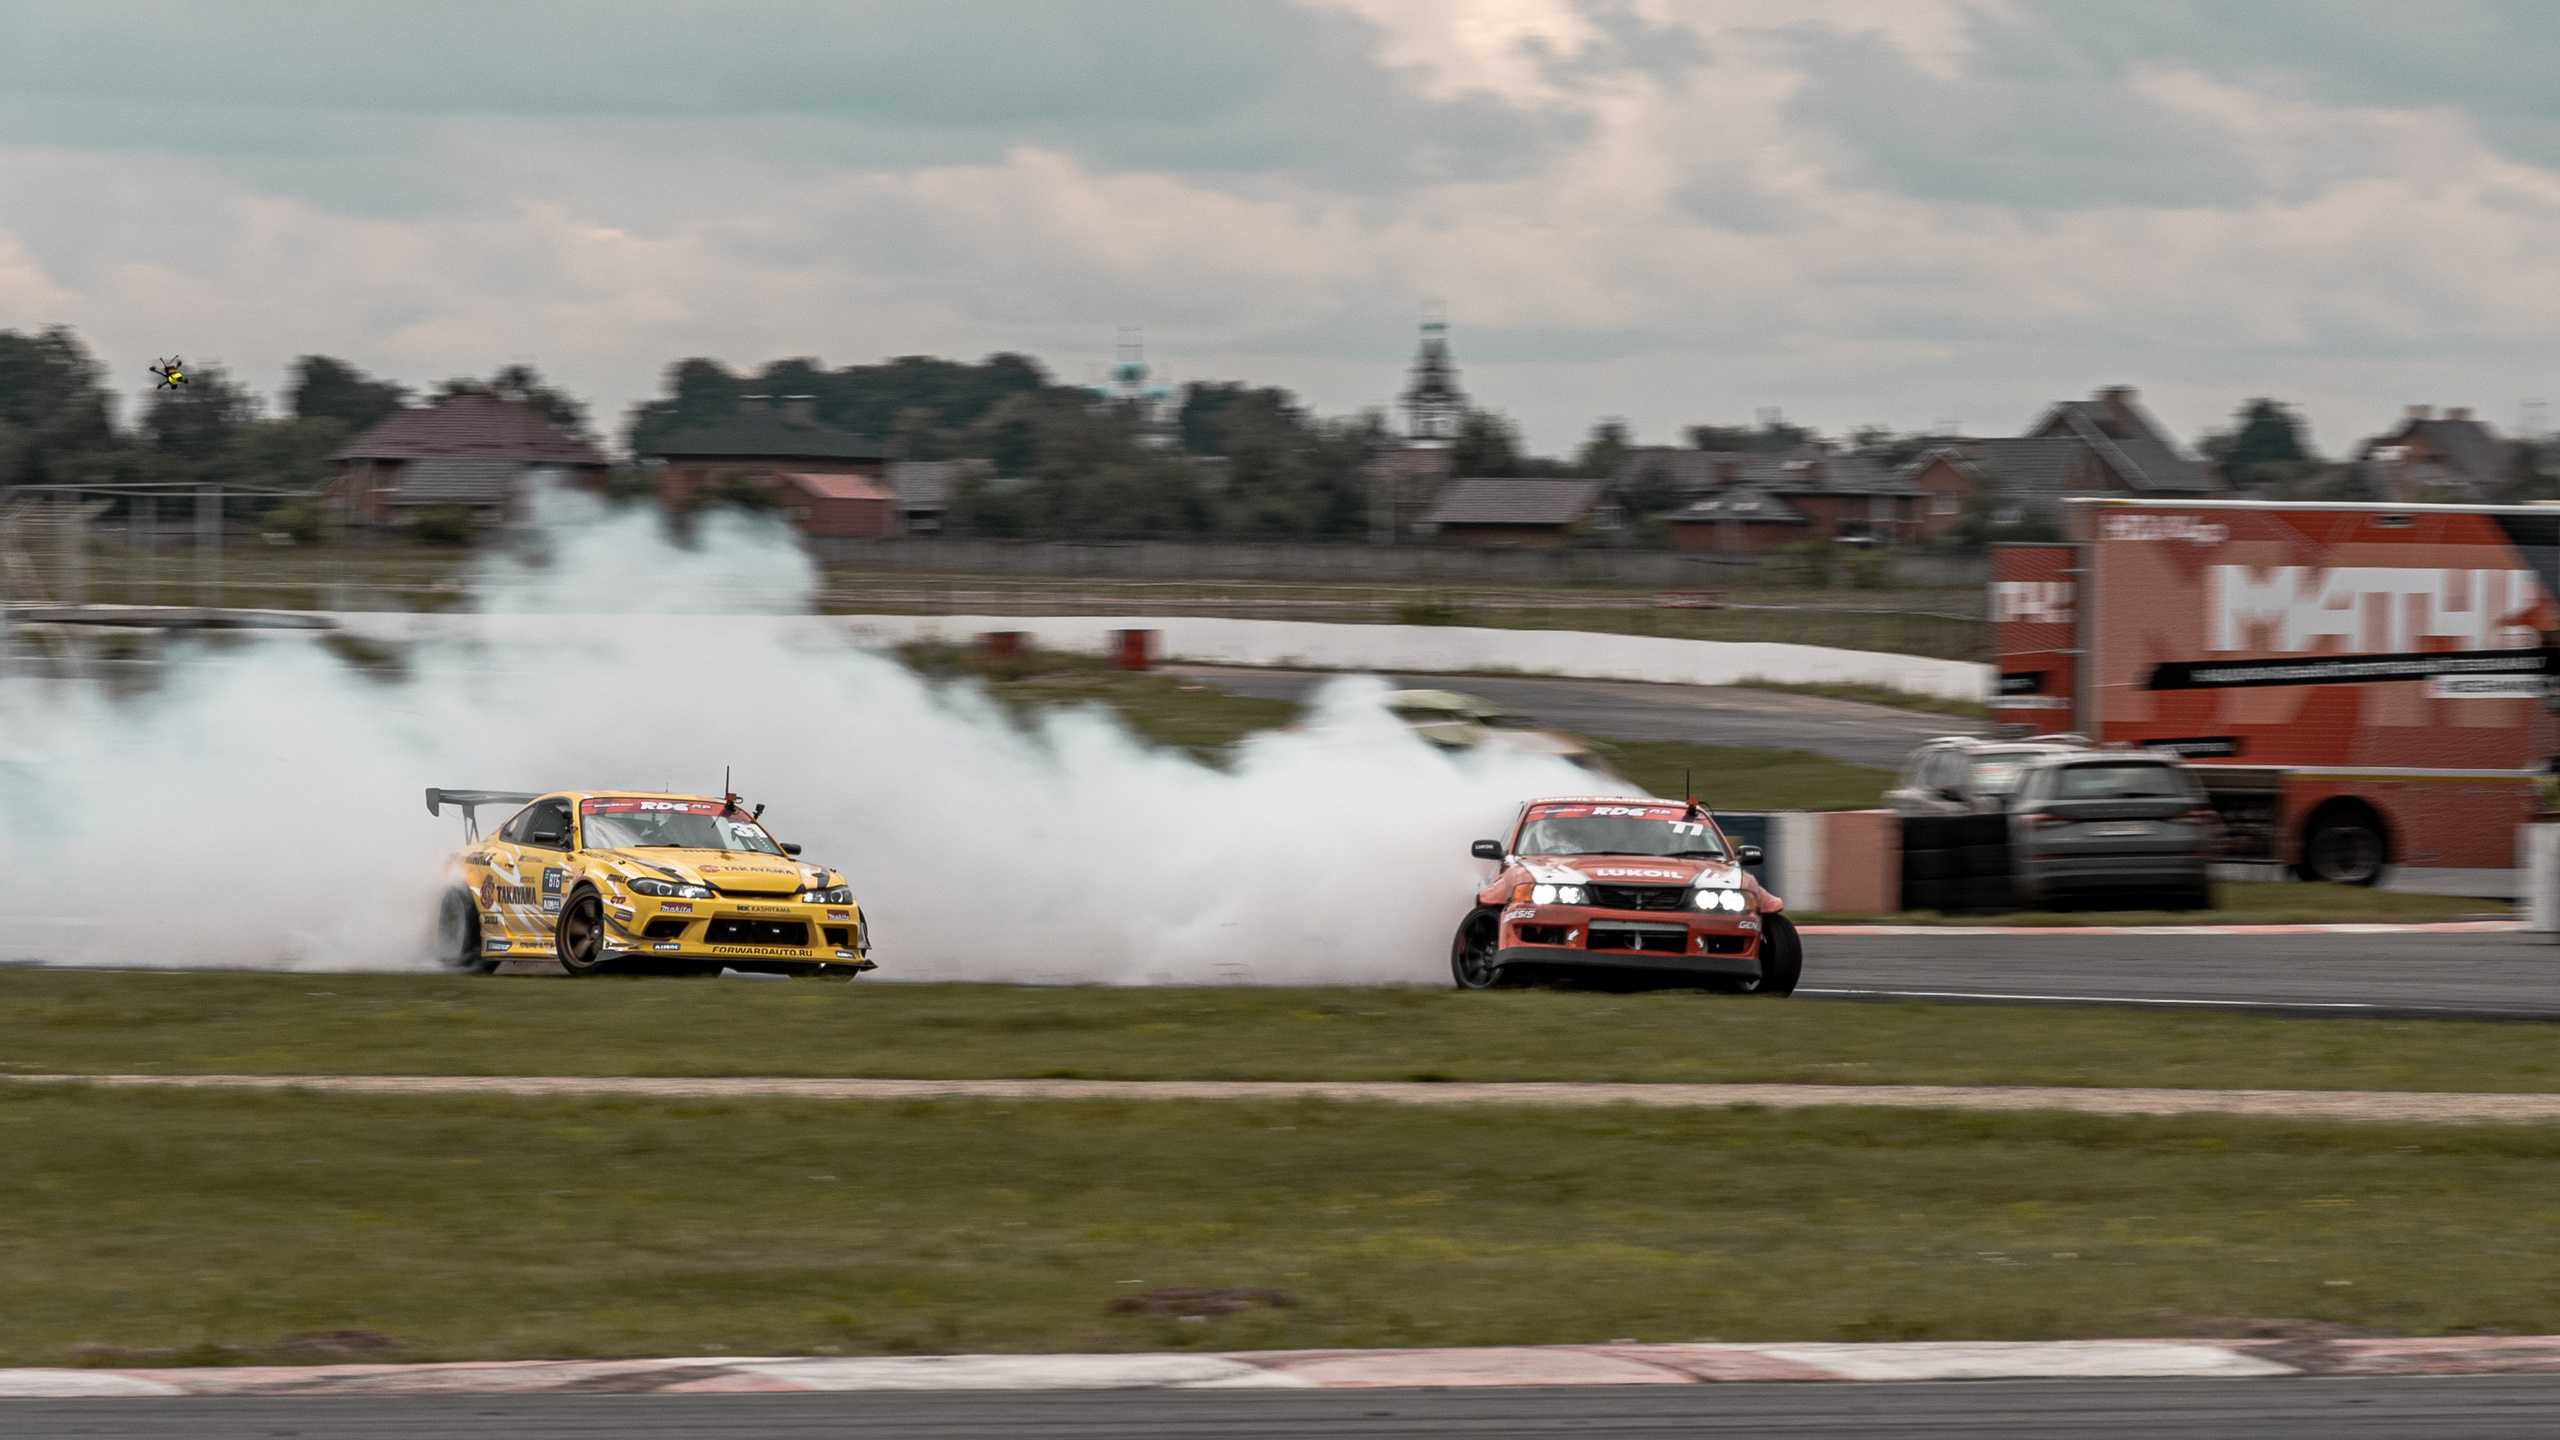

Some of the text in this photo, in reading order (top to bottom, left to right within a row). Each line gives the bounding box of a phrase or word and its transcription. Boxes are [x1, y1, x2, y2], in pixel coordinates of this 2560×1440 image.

[1668, 820, 1704, 836] 77
[722, 865, 794, 875] TAKAYAMA
[1596, 868, 1684, 879] LUKOIL
[496, 886, 537, 904] TAKAYAMA
[751, 905, 791, 913] KASHIYAMA
[712, 945, 813, 957] FORWARDAUTO.RU
